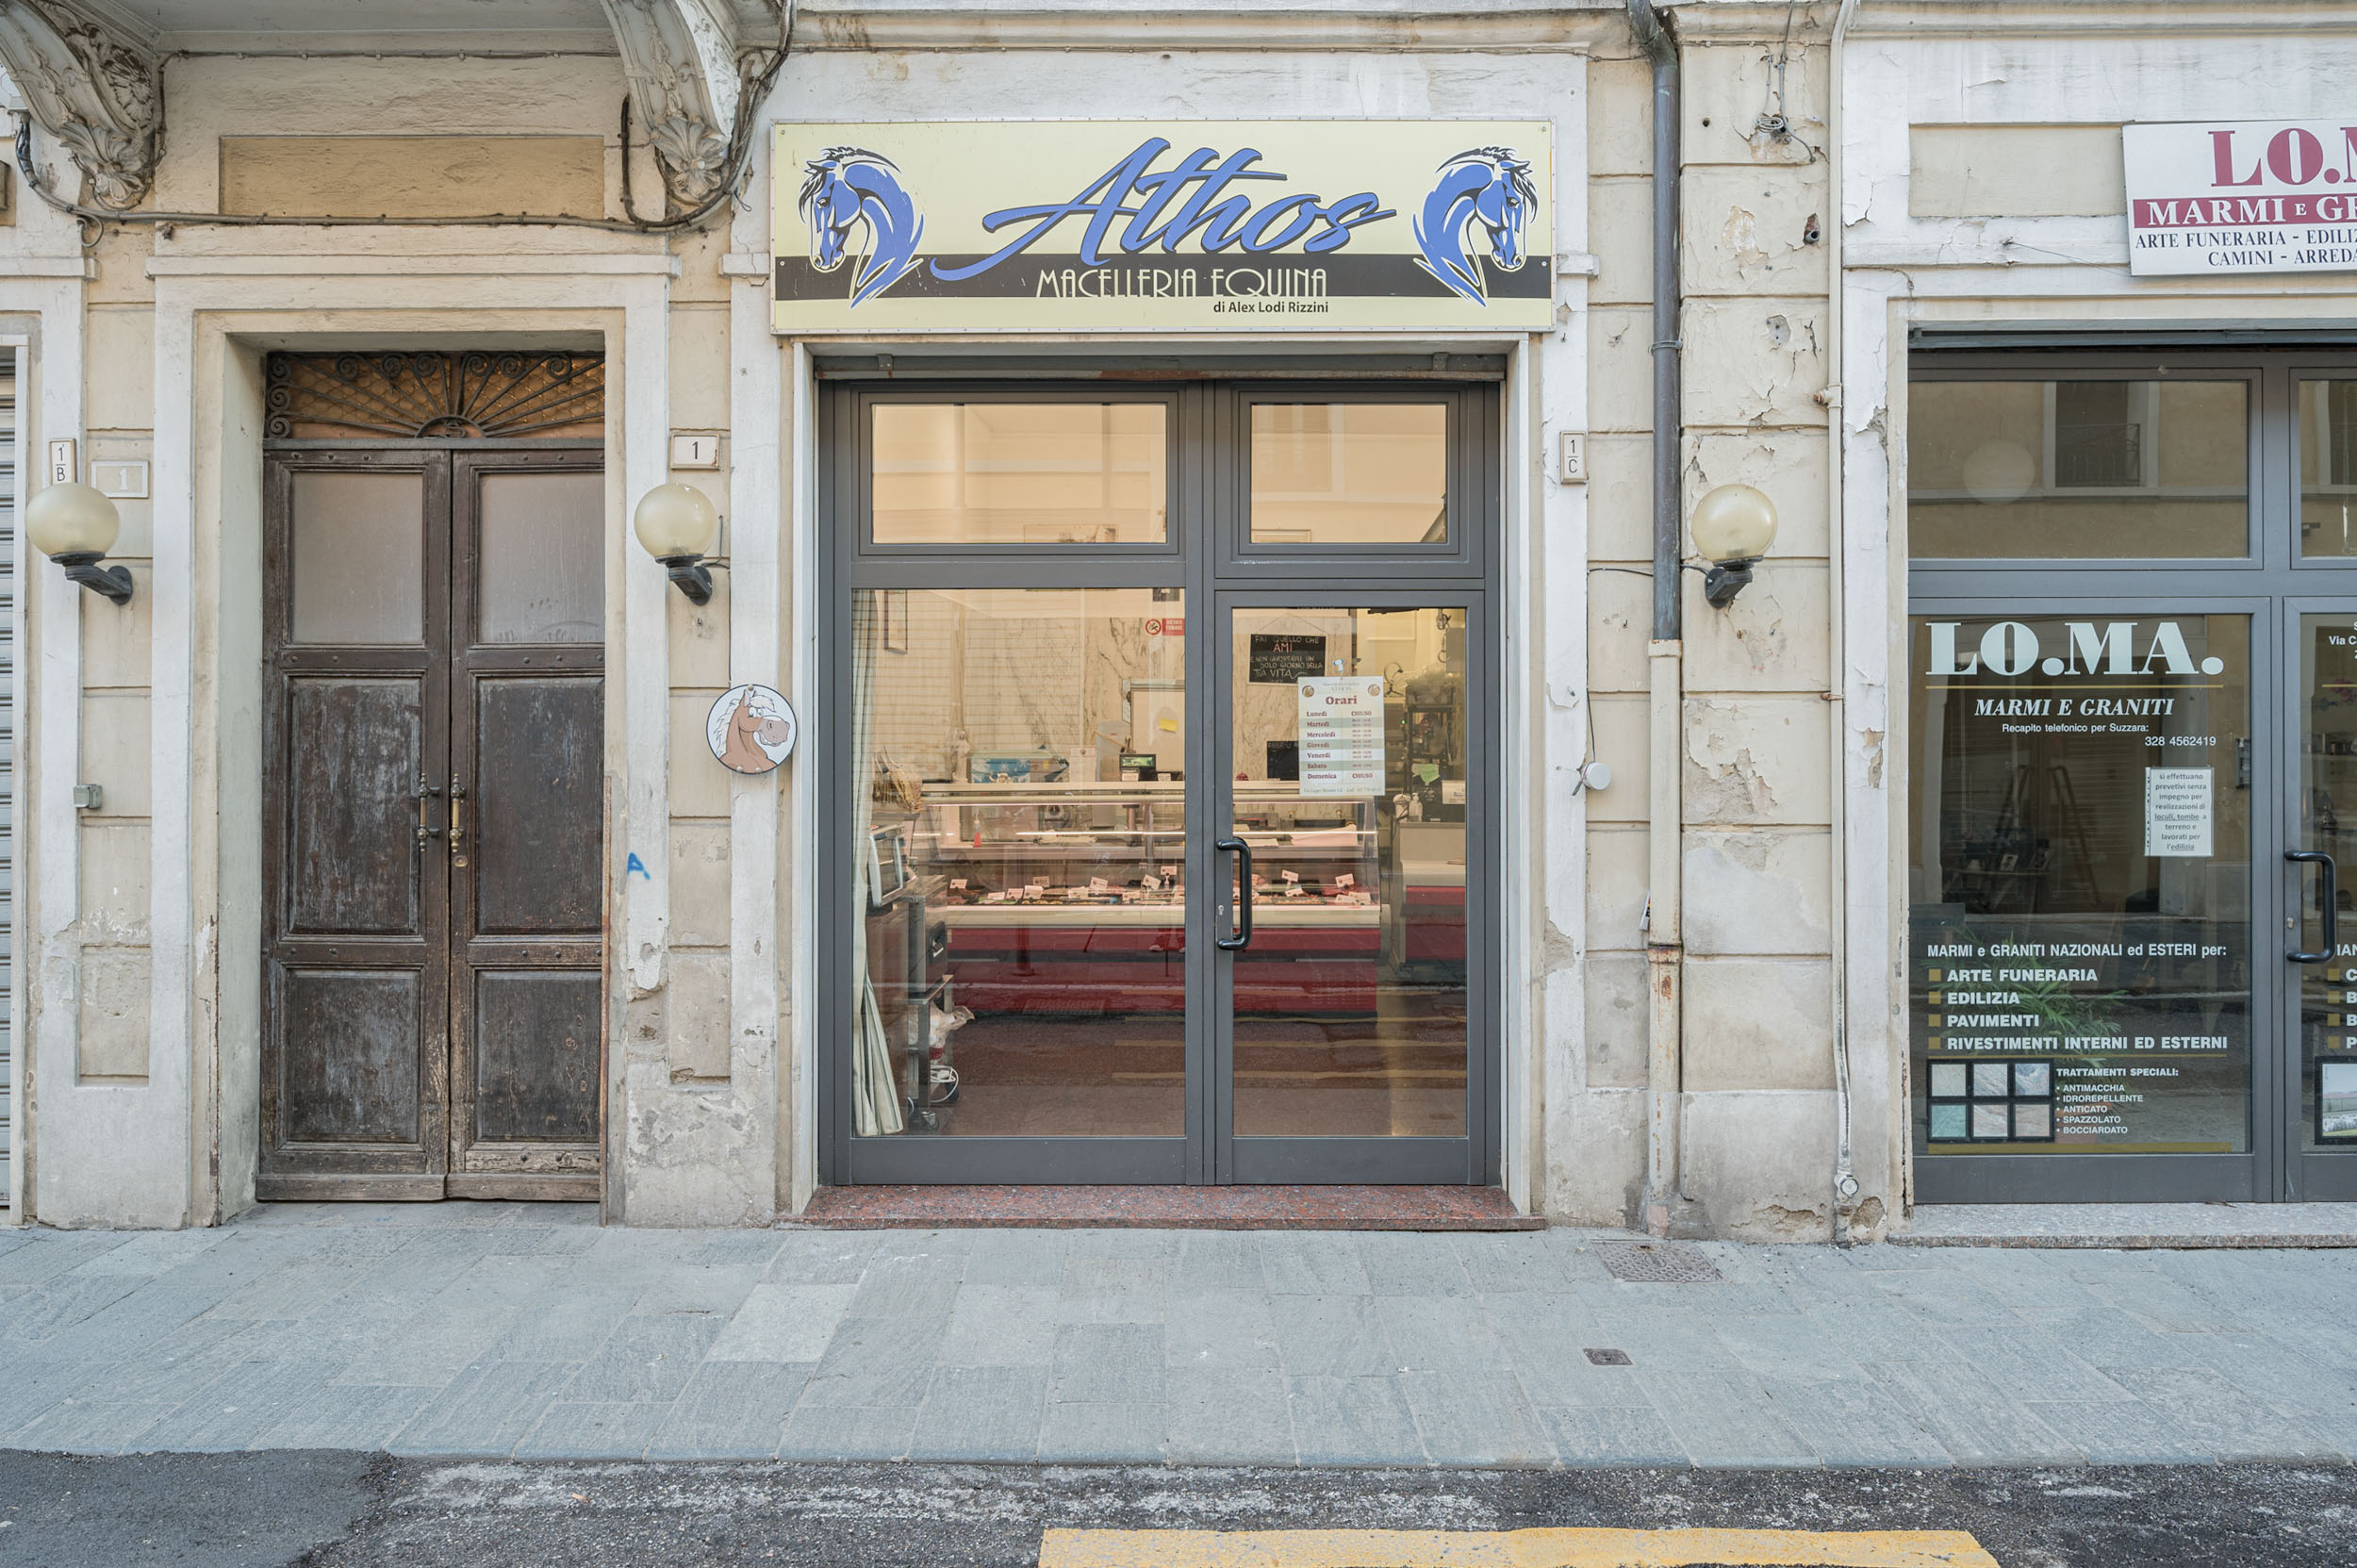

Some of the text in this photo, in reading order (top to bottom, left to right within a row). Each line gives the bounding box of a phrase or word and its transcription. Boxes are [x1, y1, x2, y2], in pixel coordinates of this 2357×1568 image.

[930, 137, 1397, 281] Athos
[2147, 198, 2286, 226] MARMI
[2295, 203, 2307, 216] E
[2135, 233, 2179, 249] ARTE
[2186, 230, 2286, 247] FUNERARIA
[2307, 228, 2357, 244] EDILI
[2208, 250, 2273, 266] CAMINI
[1036, 268, 1327, 298] MACELLERIA EQUINA
[1213, 302, 1328, 313] di Alex Lodi Rizzini
[692, 441, 699, 460] 1
[1570, 438, 1576, 454] 1
[58, 446, 64, 461] 1
[1568, 458, 1578, 474] C
[57, 467, 66, 482] B
[119, 467, 129, 491] 1
[1273, 642, 1294, 652] AMI
[2328, 635, 2346, 646] Via
[1925, 621, 2225, 676] LO.MA.
[1269, 668, 1292, 678] VITA
[1325, 695, 1358, 705] Orari
[1974, 698, 2175, 717] MARMI E GRANITI
[2002, 722, 2150, 734] Recapito telefonico per Suzzara:
[2144, 735, 2217, 747] 328 4562419
[1927, 944, 2227, 959] MARMI e GRANITI NAZIONALI ed ESTERI per:
[1947, 968, 2098, 982] ARTE FUNERARIA
[1947, 992, 2020, 1004] EDILIZIA
[1947, 1015, 2039, 1027] PAVIMENTI
[1947, 1036, 2228, 1049] RIVESTIMENTI INTERNI ED ESTERNI
[2056, 1067, 2180, 1077] TRATTAMENTI SPECIALI:
[2063, 1083, 2125, 1092] ANTIMACCHIA
[2063, 1105, 2108, 1114] ANTICATO
[2063, 1115, 2121, 1124] SPAZZOLATO
[2063, 1126, 2128, 1134] BOCCIARDATO
